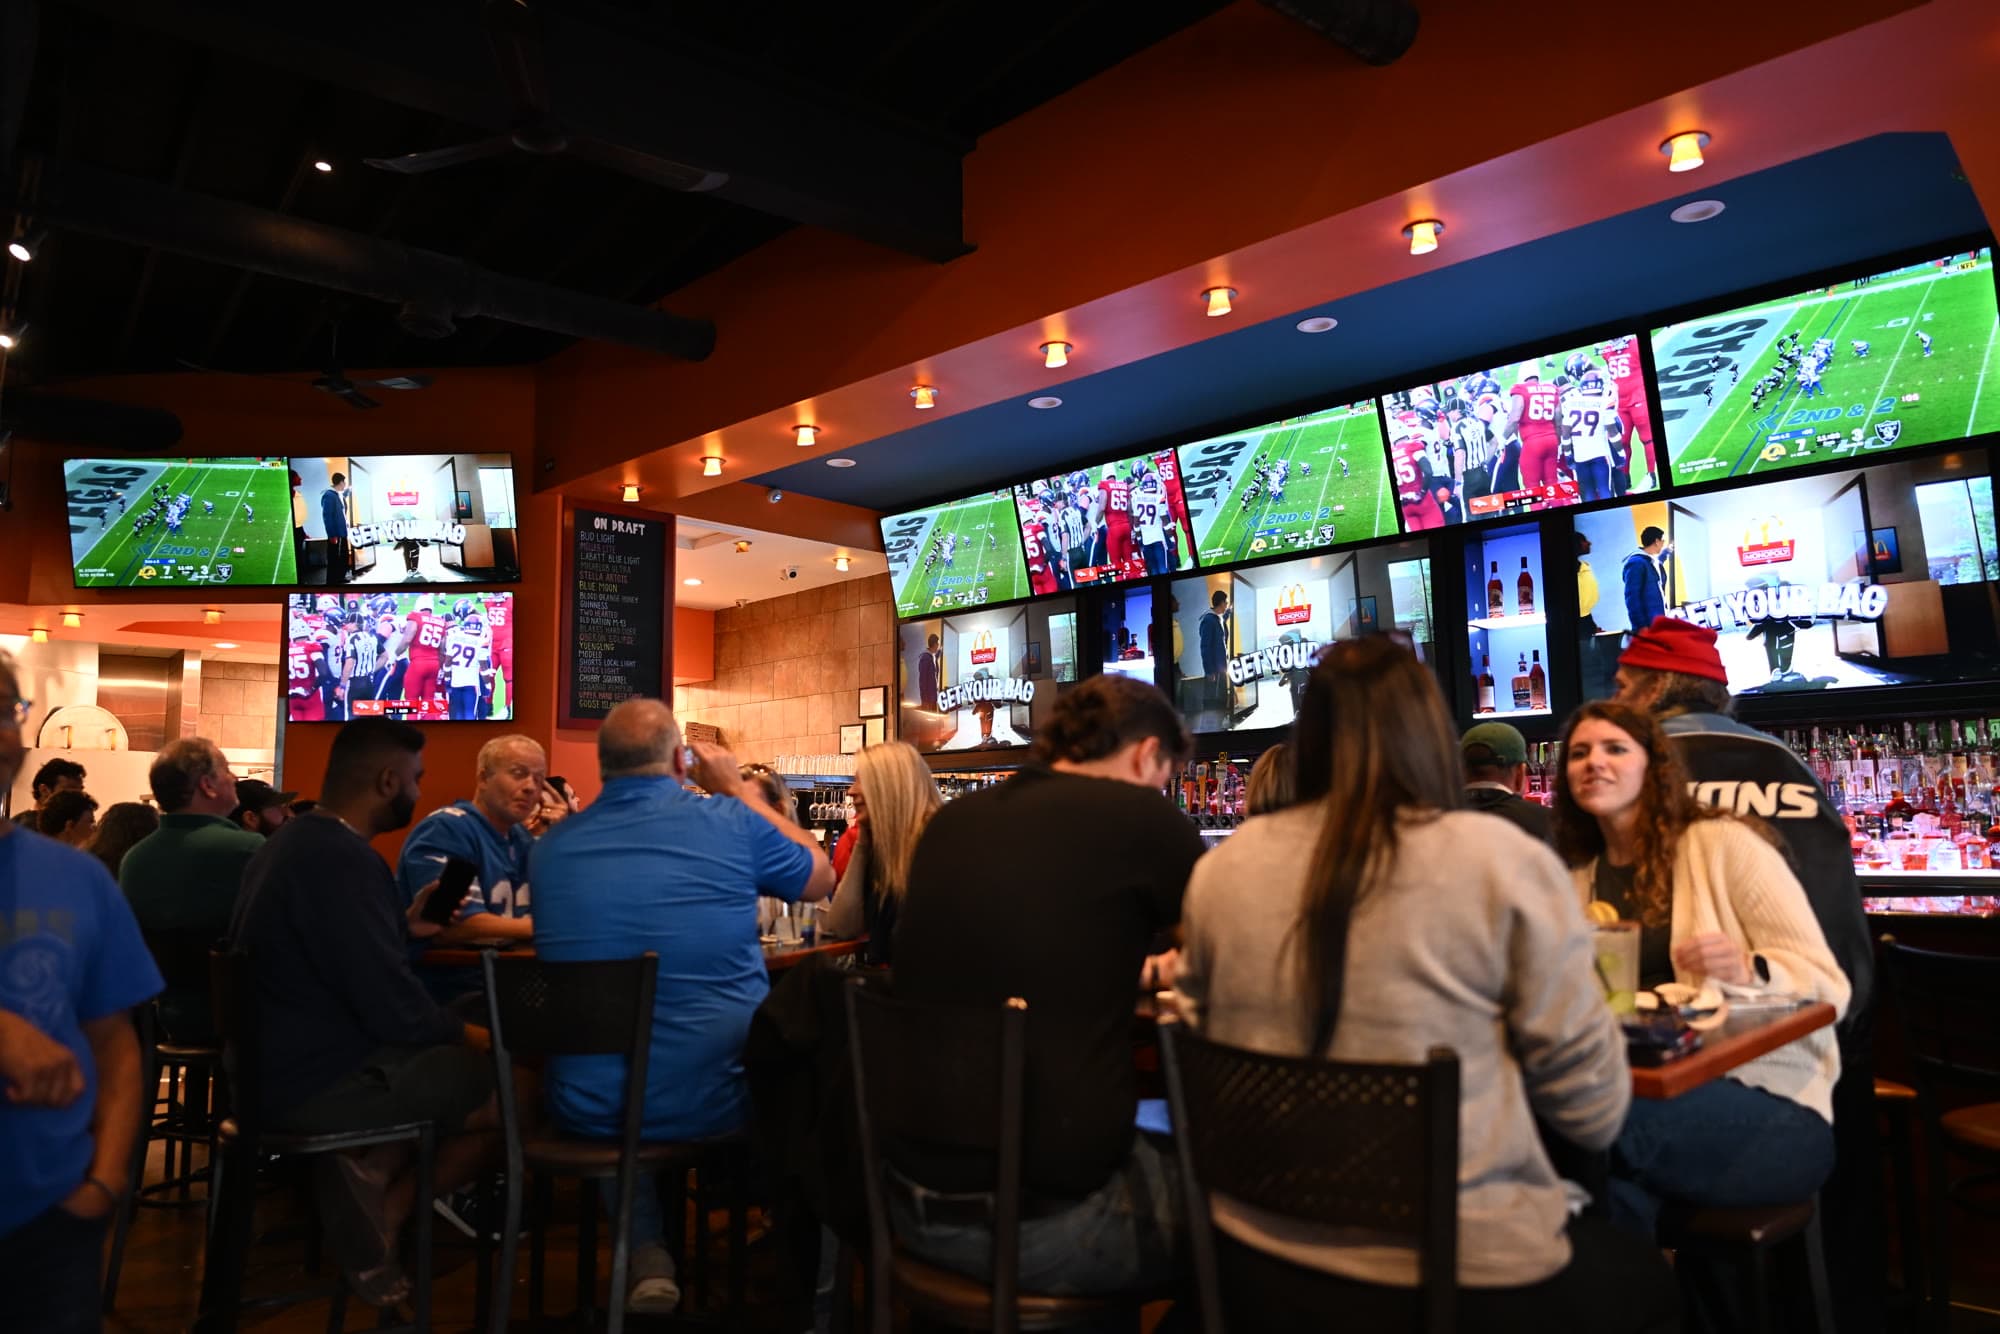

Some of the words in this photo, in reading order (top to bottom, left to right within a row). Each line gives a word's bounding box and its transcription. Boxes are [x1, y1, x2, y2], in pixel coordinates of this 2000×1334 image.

[1528, 394, 1555, 421] 65
[1785, 407, 1842, 426] 2ND
[1845, 403, 1865, 418] &
[1872, 397, 1897, 414] 2
[1569, 409, 1600, 437] 29
[1851, 428, 1864, 441] 3
[1794, 438, 1807, 452] 7
[1546, 486, 1556, 497] 3
[1110, 489, 1128, 511] 65
[1136, 503, 1157, 526] 29
[1265, 513, 1298, 525] 2ND
[1302, 511, 1312, 521] &
[1318, 507, 1331, 519] 2
[349, 524, 381, 548] GET
[430, 519, 467, 545] BAG
[594, 517, 608, 531] ON
[611, 520, 646, 536] DRAFT
[580, 530, 595, 542] BUD
[596, 533, 616, 545] LIGHT
[157, 544, 196, 556] 2ND
[199, 547, 211, 557] &
[215, 546, 230, 558] 2
[163, 565, 171, 575] 7
[200, 565, 209, 575] 3
[1123, 561, 1131, 571] 3
[976, 573, 985, 582] 2
[579, 580, 597, 591] BLUE
[598, 583, 618, 593] MOON
[579, 600, 609, 610] GUINNESS
[1726, 584, 1814, 625] YOUR
[1817, 582, 1889, 620] BAG
[418, 623, 444, 649] 65
[579, 641, 615, 651] YUENGLING
[451, 643, 476, 669] 29
[578, 650, 602, 659] MODELO
[1228, 651, 1263, 685] GET
[938, 685, 961, 711] GET
[964, 678, 1002, 703] YOUR
[1003, 677, 1035, 703] BAG
[372, 703, 380, 711] 6
[421, 701, 429, 711] 3
